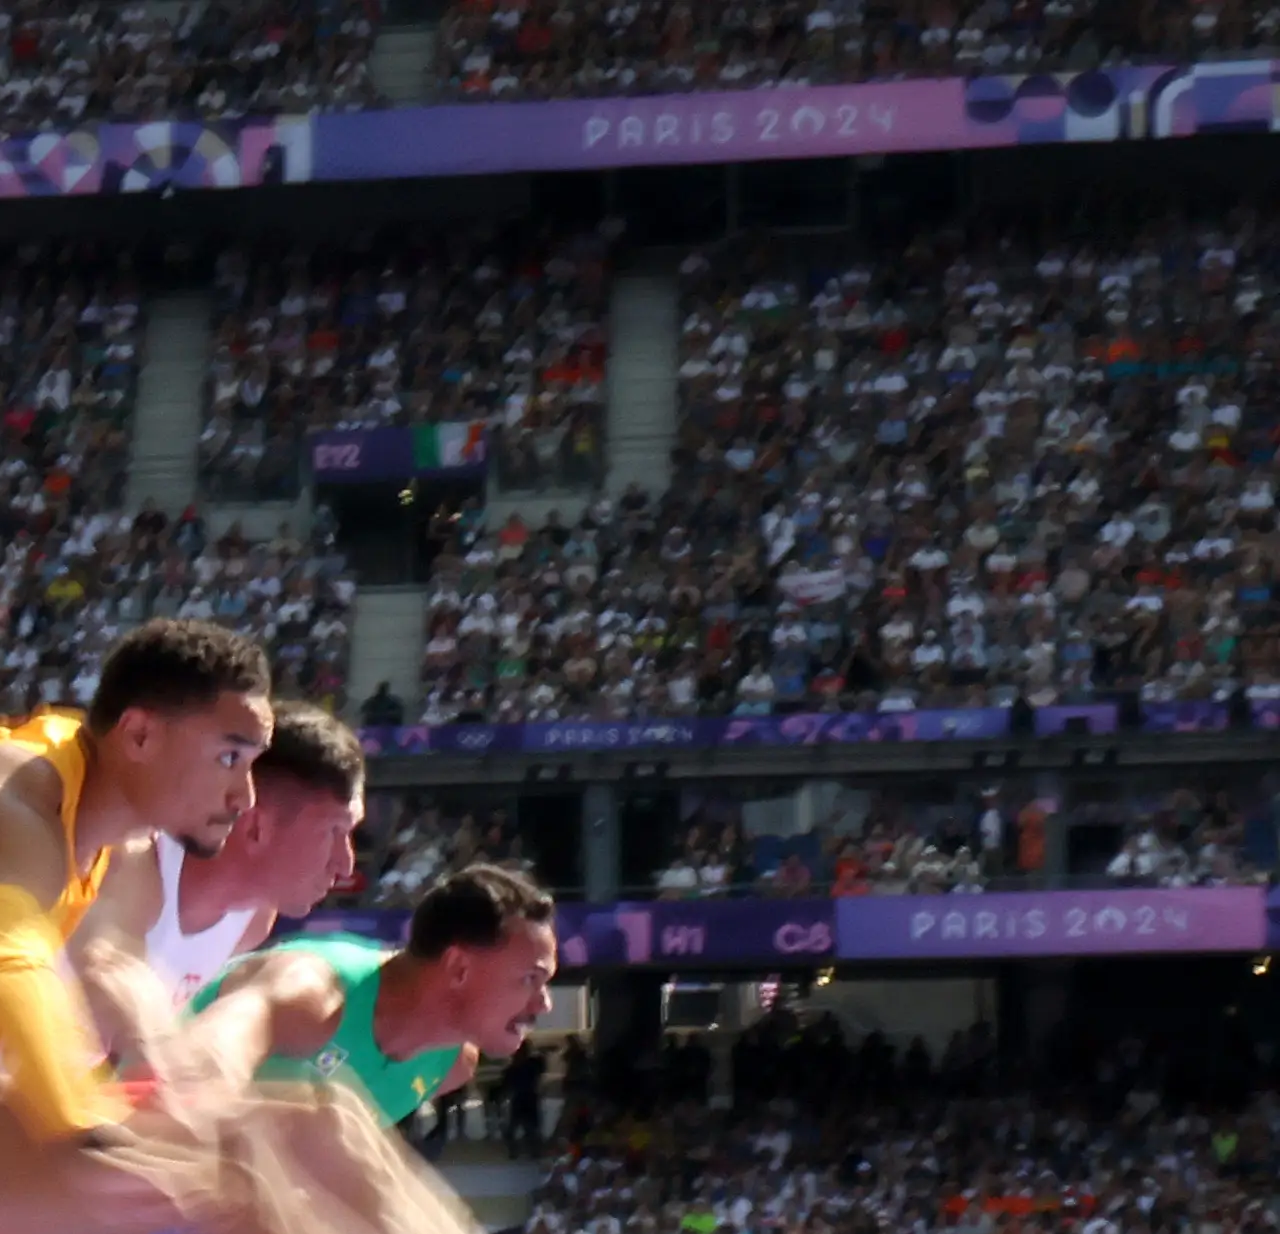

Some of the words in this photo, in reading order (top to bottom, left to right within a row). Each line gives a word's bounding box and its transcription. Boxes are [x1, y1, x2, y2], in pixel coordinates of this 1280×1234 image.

[583, 112, 734, 150] PARIS
[757, 104, 894, 142] 2024
[910, 909, 1046, 940] PARIS
[1063, 905, 1188, 938] 2024
